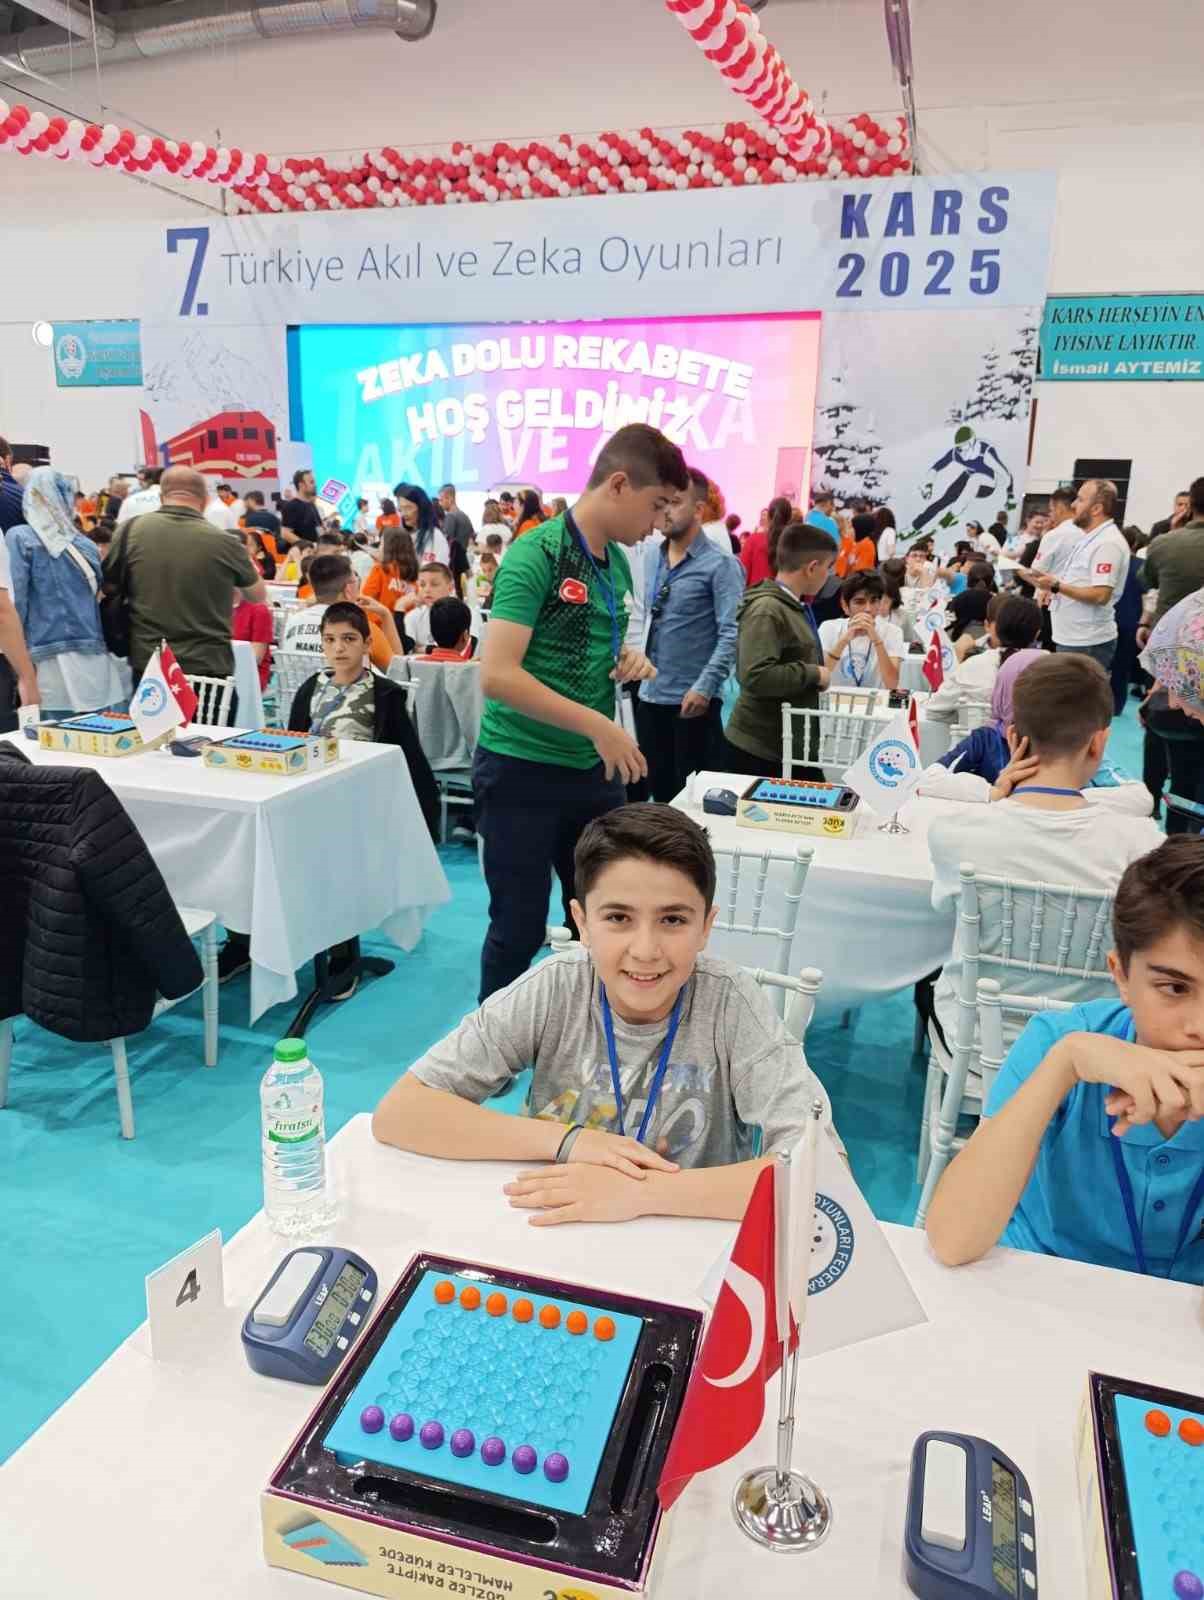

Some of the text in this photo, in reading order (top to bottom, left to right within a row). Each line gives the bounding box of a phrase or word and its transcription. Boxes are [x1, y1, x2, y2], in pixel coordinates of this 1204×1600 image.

[840, 186, 1010, 239] KARS
[166, 227, 783, 316] 7. Türkiye Akıl ve Zeka Oyunları
[836, 249, 1001, 298] 2025
[1051, 306, 1094, 324] KARS
[356, 335, 754, 404] ZEKA DOLU REKABETE
[1114, 358, 1202, 375] AYTEMİZ
[406, 392, 490, 445] HOŞ
[312, 745, 320, 758] 5
[175, 1267, 201, 1308] 4
[386, 1563, 445, 1588] RAKİPTE
[436, 1562, 513, 1591] HAMLELER
